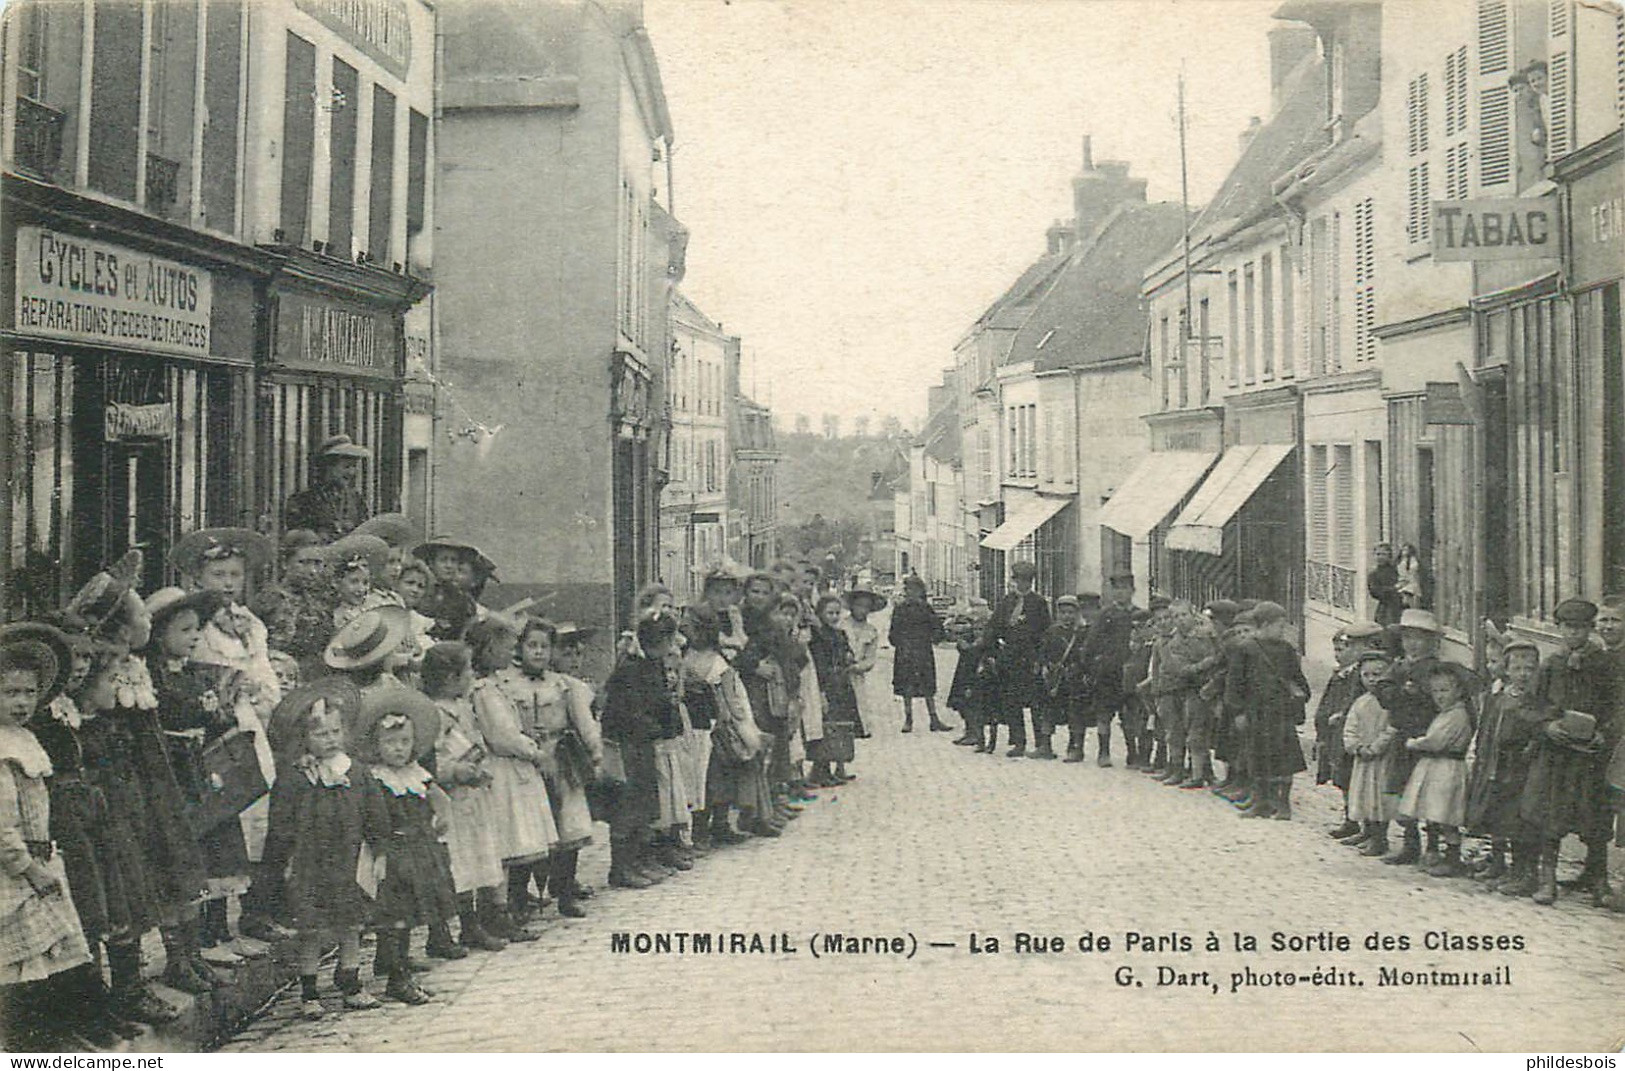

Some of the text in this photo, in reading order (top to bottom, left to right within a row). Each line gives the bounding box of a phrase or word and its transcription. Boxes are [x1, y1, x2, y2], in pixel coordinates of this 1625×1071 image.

[1438, 207, 1549, 248] TABAC
[39, 234, 197, 312] CYCLES et AUTOS
[21, 295, 206, 349] REPARATIONS PIECES DETACHEES
